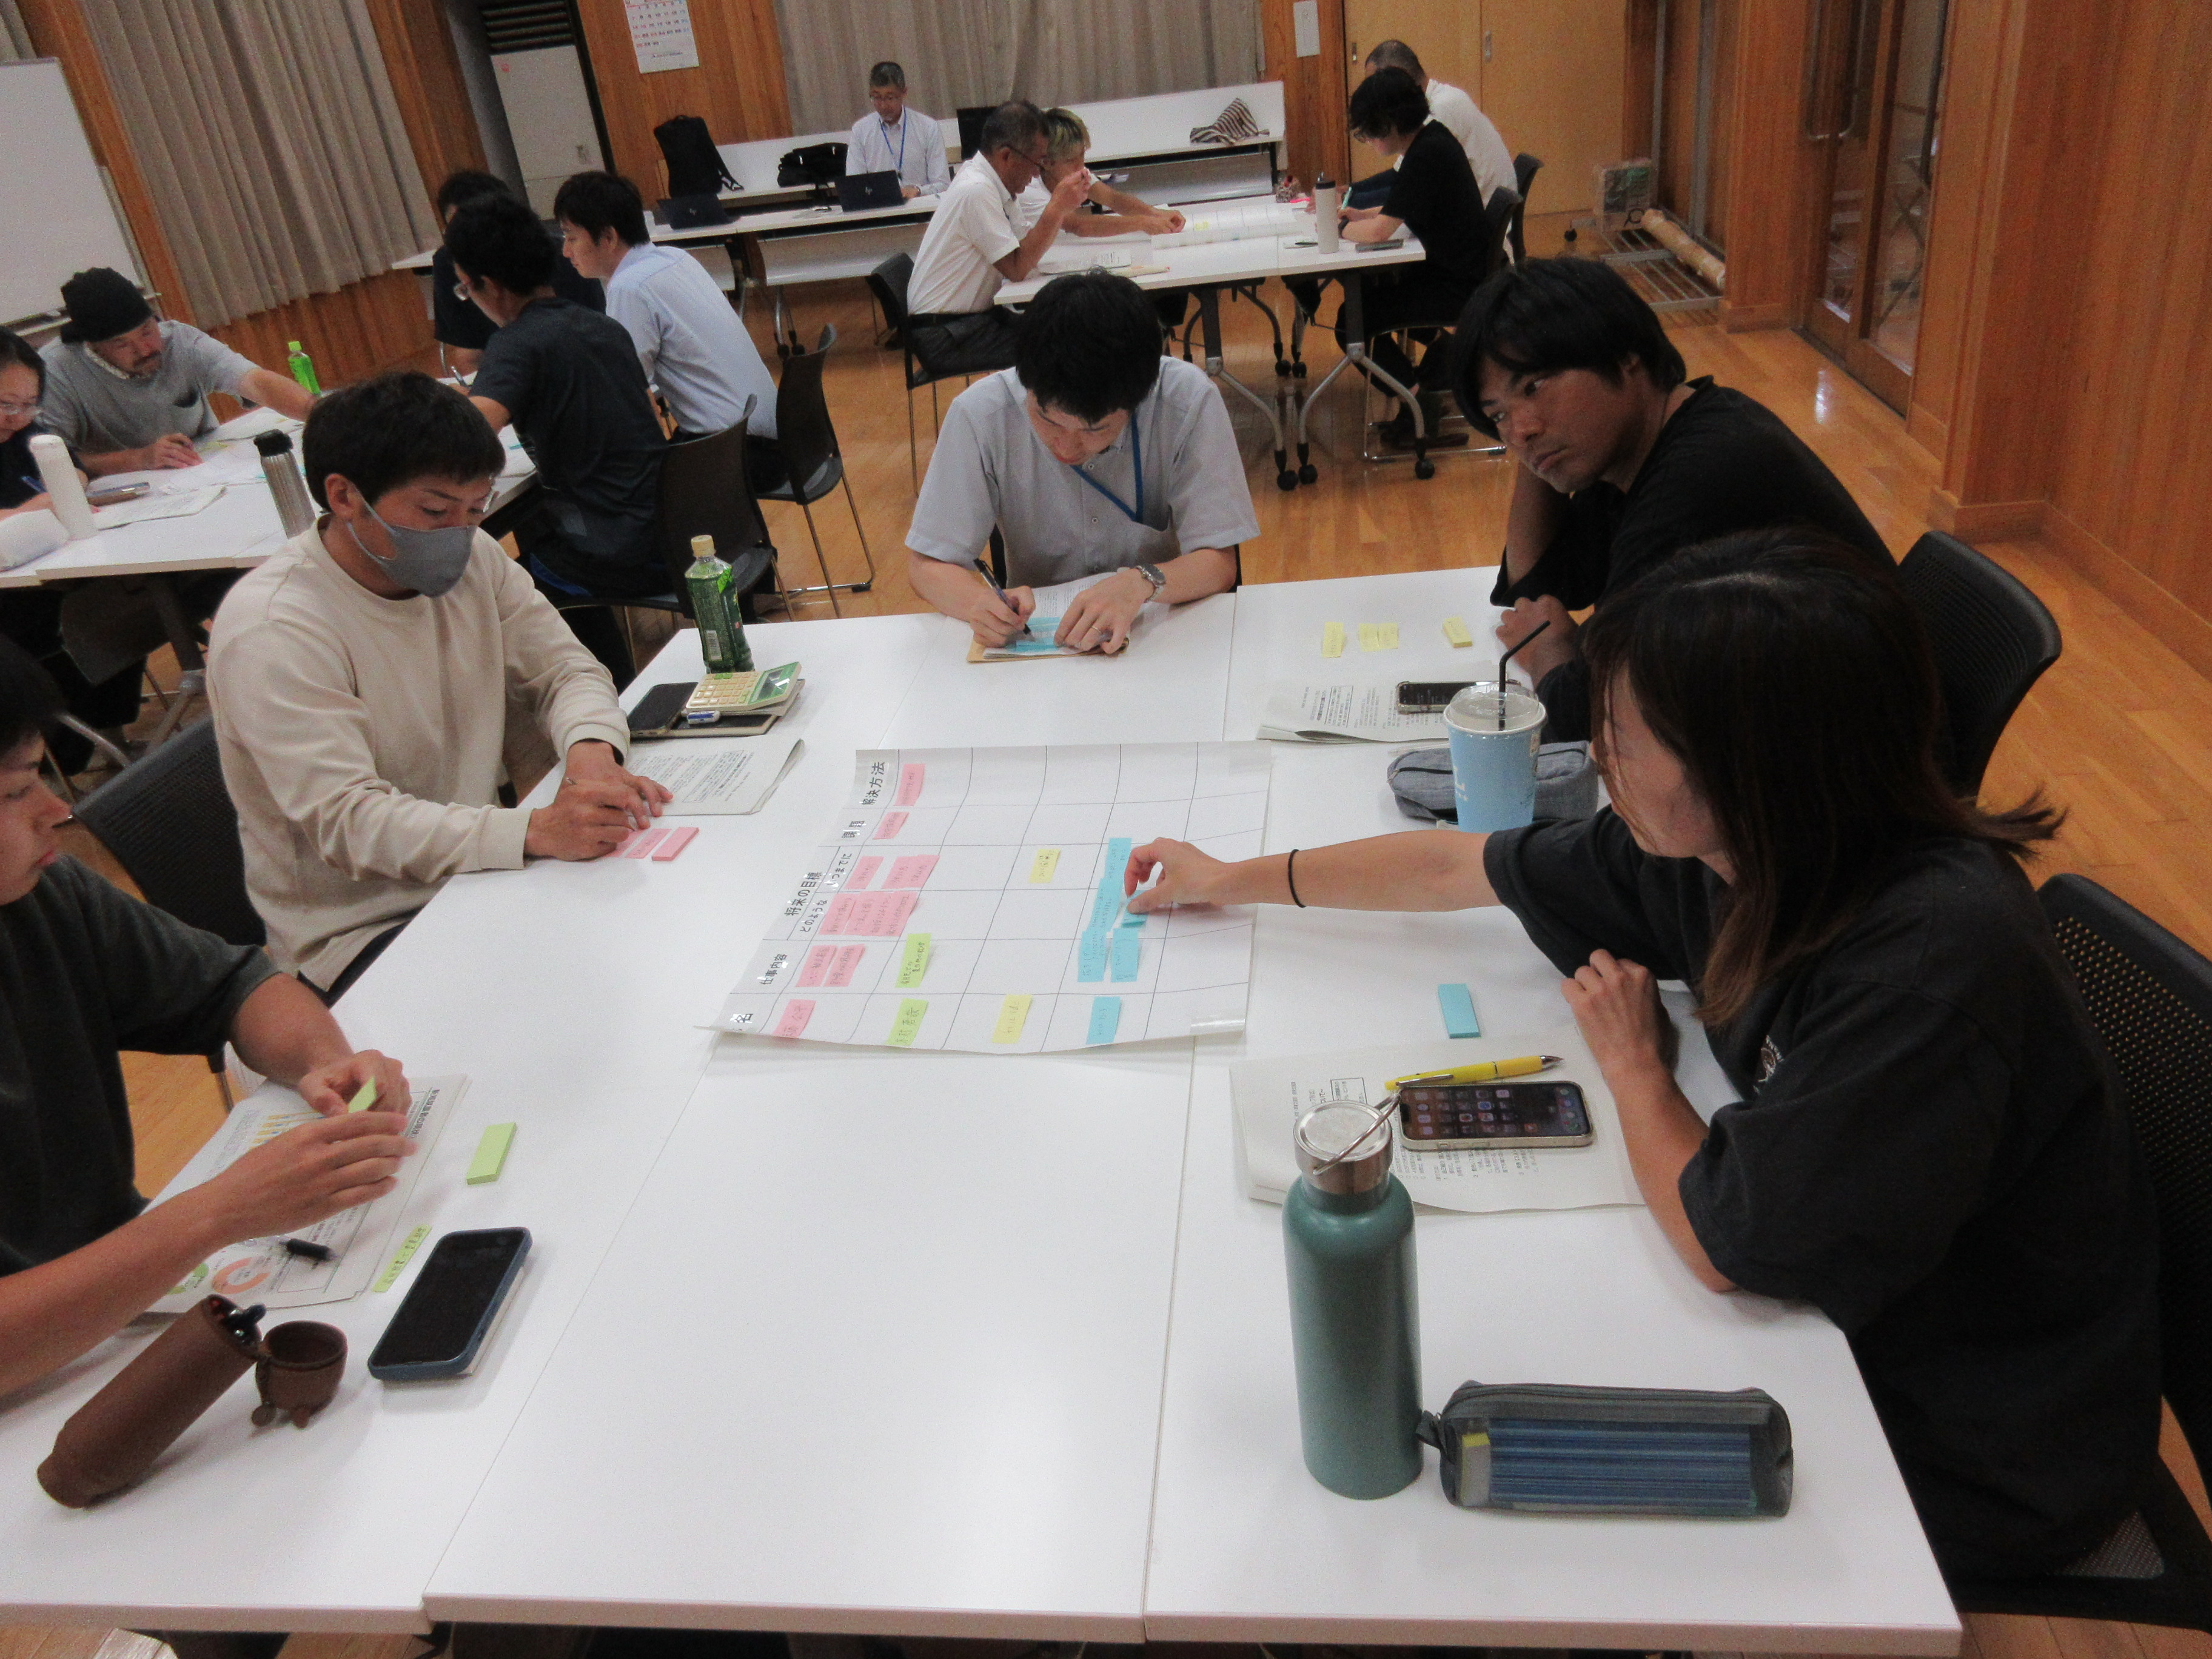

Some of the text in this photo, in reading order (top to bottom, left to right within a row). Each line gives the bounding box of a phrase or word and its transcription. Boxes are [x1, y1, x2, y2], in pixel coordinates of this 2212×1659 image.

[860, 762, 885, 805] 解決方法
[784, 872, 822, 916] 将来の目標
[760, 954, 787, 985] 仕事内容
